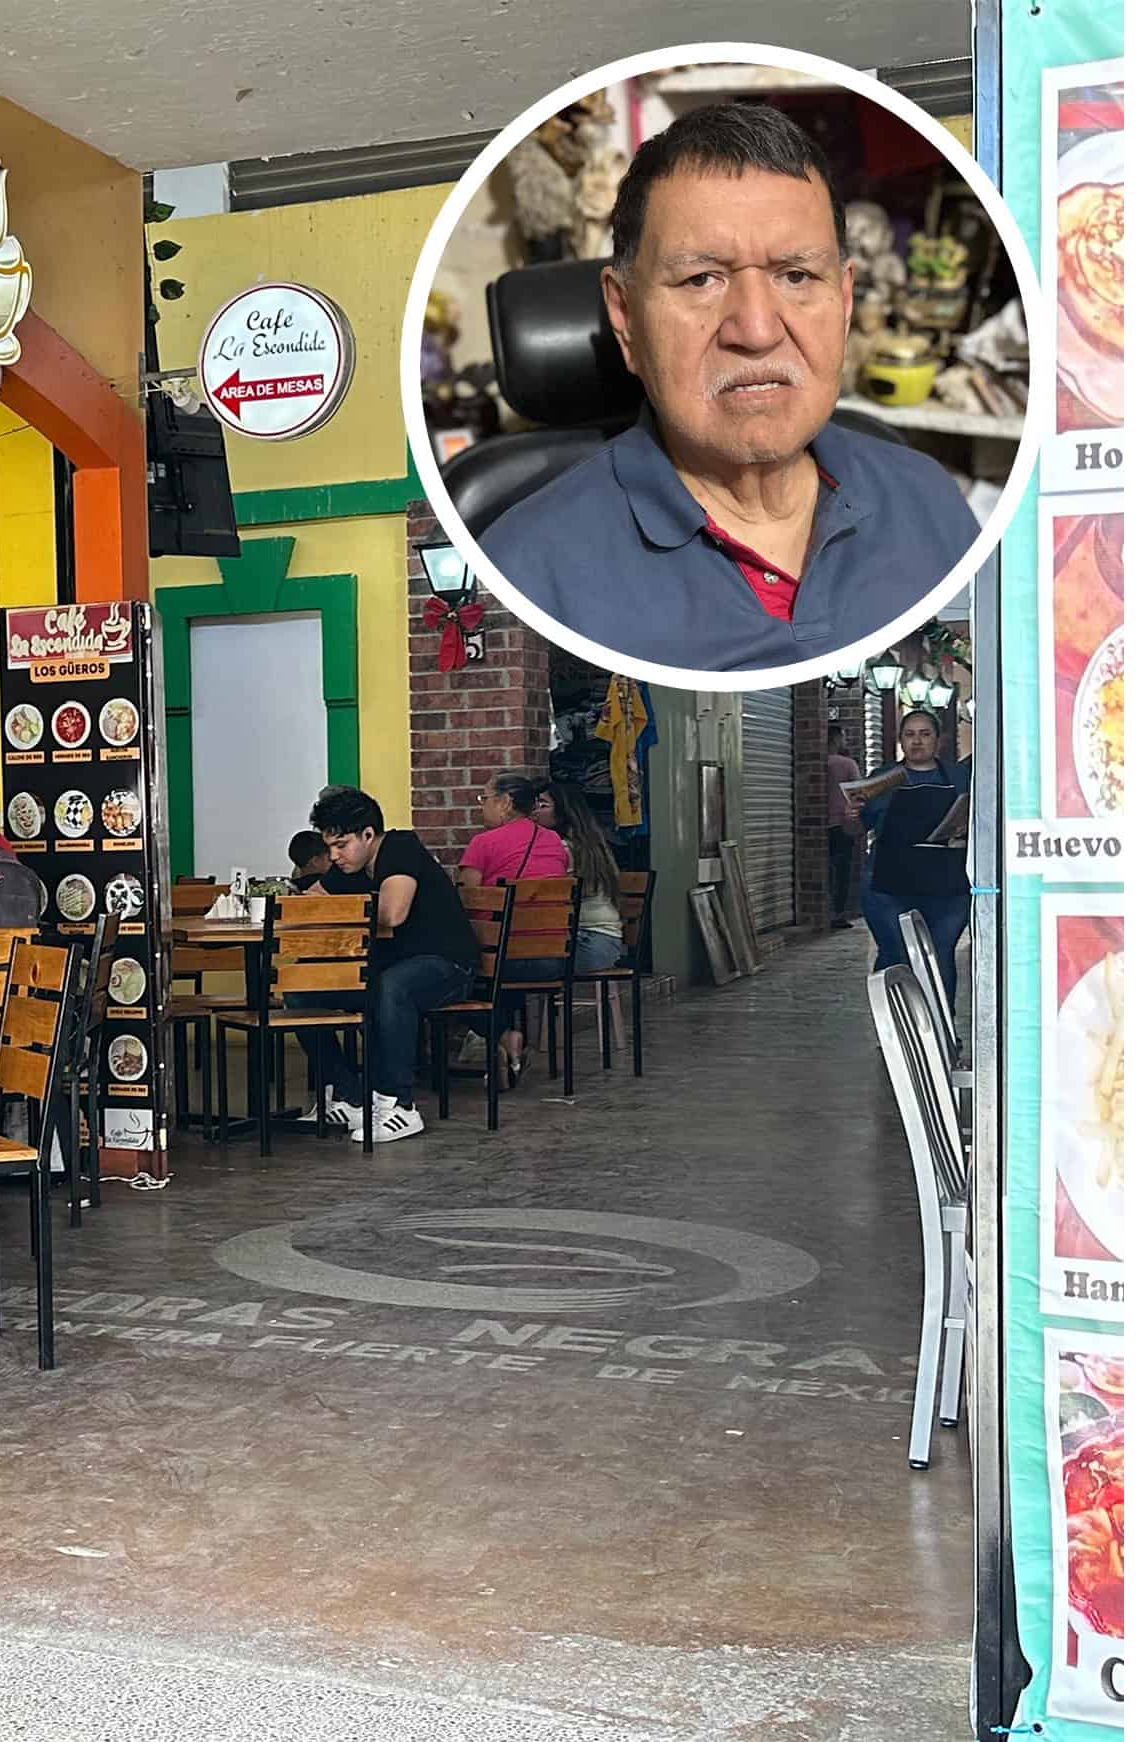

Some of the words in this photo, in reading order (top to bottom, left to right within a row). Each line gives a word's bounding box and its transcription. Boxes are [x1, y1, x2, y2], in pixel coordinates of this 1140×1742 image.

[213, 336, 245, 360] La
[220, 385, 255, 400] AREA
[257, 384, 274, 396] DE
[276, 378, 323, 395] MESAS
[1076, 442, 1123, 470] Ho
[44, 606, 87, 637] Café
[34, 665, 57, 677] LOS
[59, 662, 105, 675] GÜEROS
[1016, 832, 1122, 858] Huevo
[451, 1319, 918, 1377] NEGRA
[596, 1363, 685, 1385] DE
[723, 1375, 914, 1404] MEXIC
